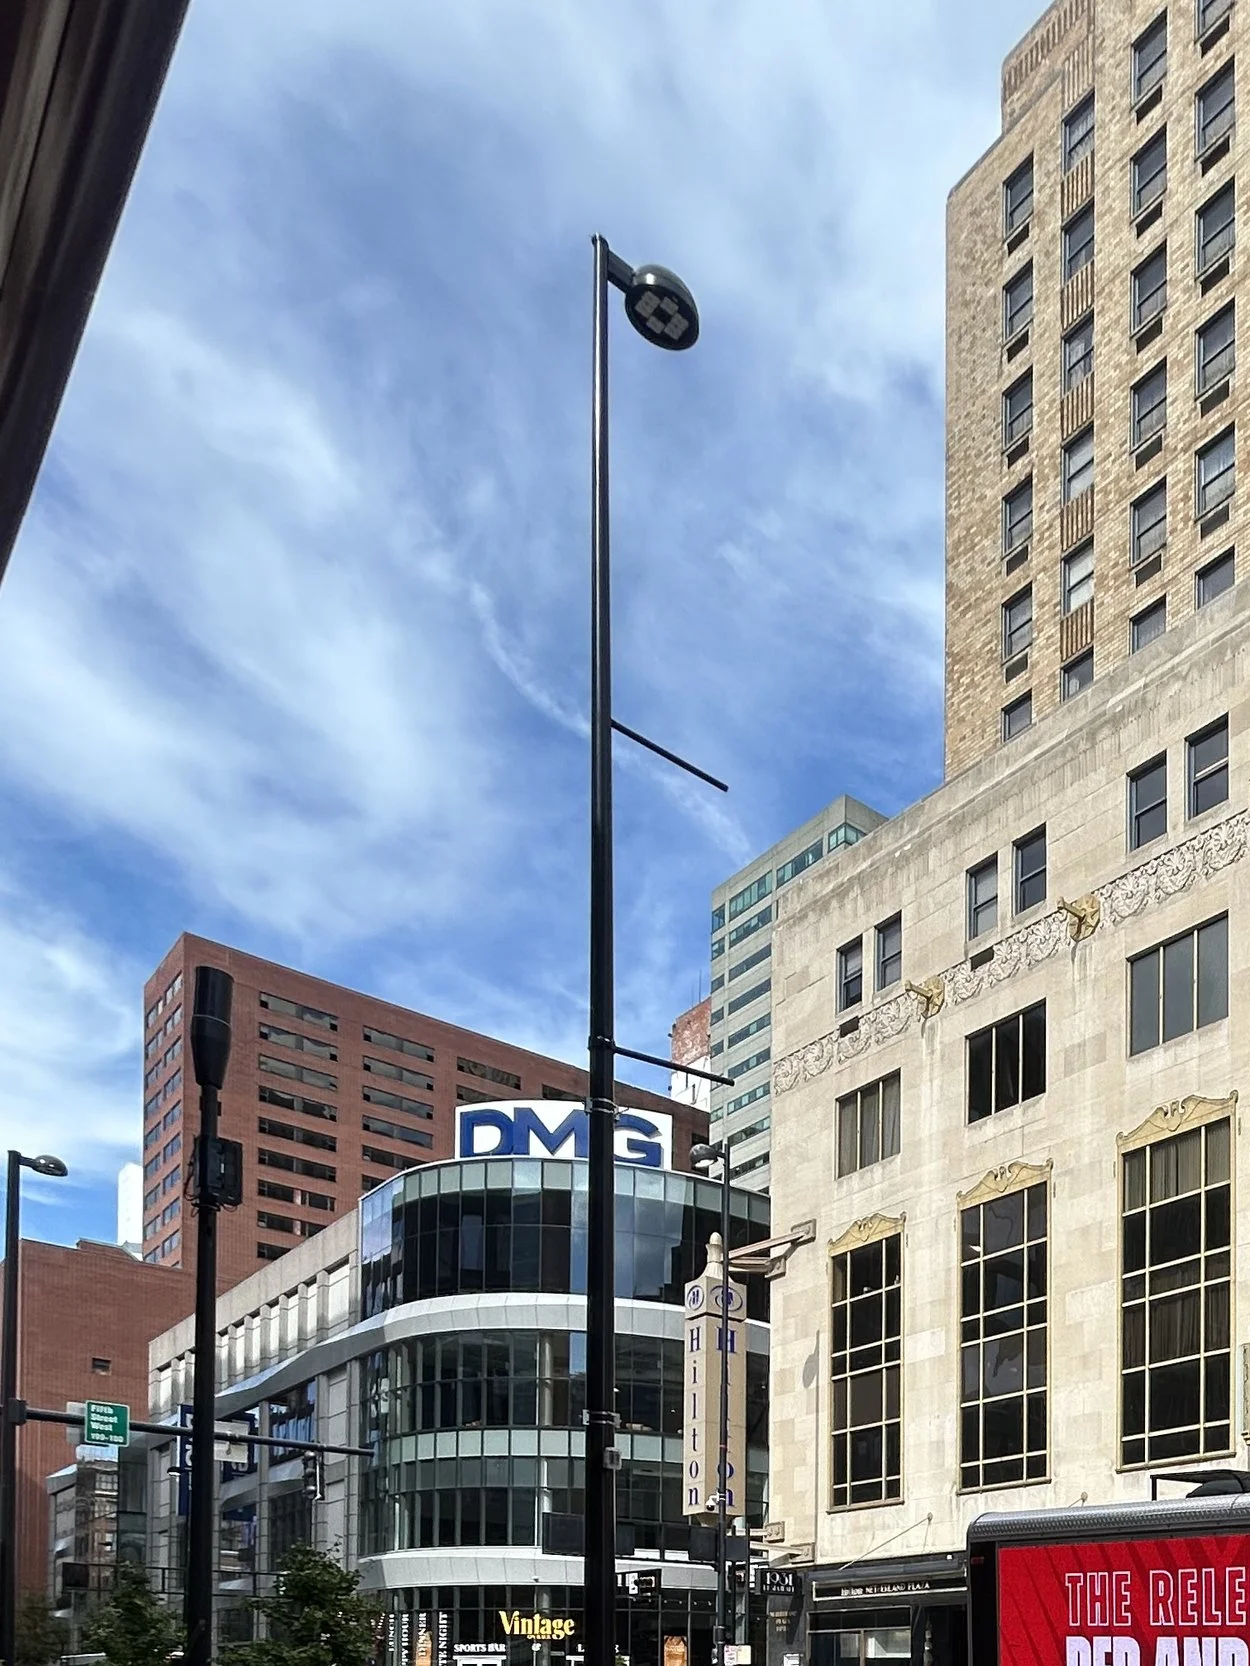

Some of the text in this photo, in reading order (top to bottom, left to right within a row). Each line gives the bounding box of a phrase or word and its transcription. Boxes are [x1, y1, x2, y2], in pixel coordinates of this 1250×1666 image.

[460, 1107, 665, 1167] DMG
[91, 1404, 113, 1414] Fifth
[91, 1413, 118, 1423] Street
[688, 1325, 701, 1506] Hilton
[91, 1421, 113, 1431] West
[766, 1572, 793, 1586] 1931
[1065, 1570, 1131, 1627] THE
[401, 1613, 410, 1647] HOUR
[418, 1612, 427, 1657] DINNER
[438, 1611, 448, 1649] NIGHT
[498, 1610, 575, 1640] Vintage
[453, 1643, 487, 1653] SPORTS
[487, 1642, 506, 1653] BAR
